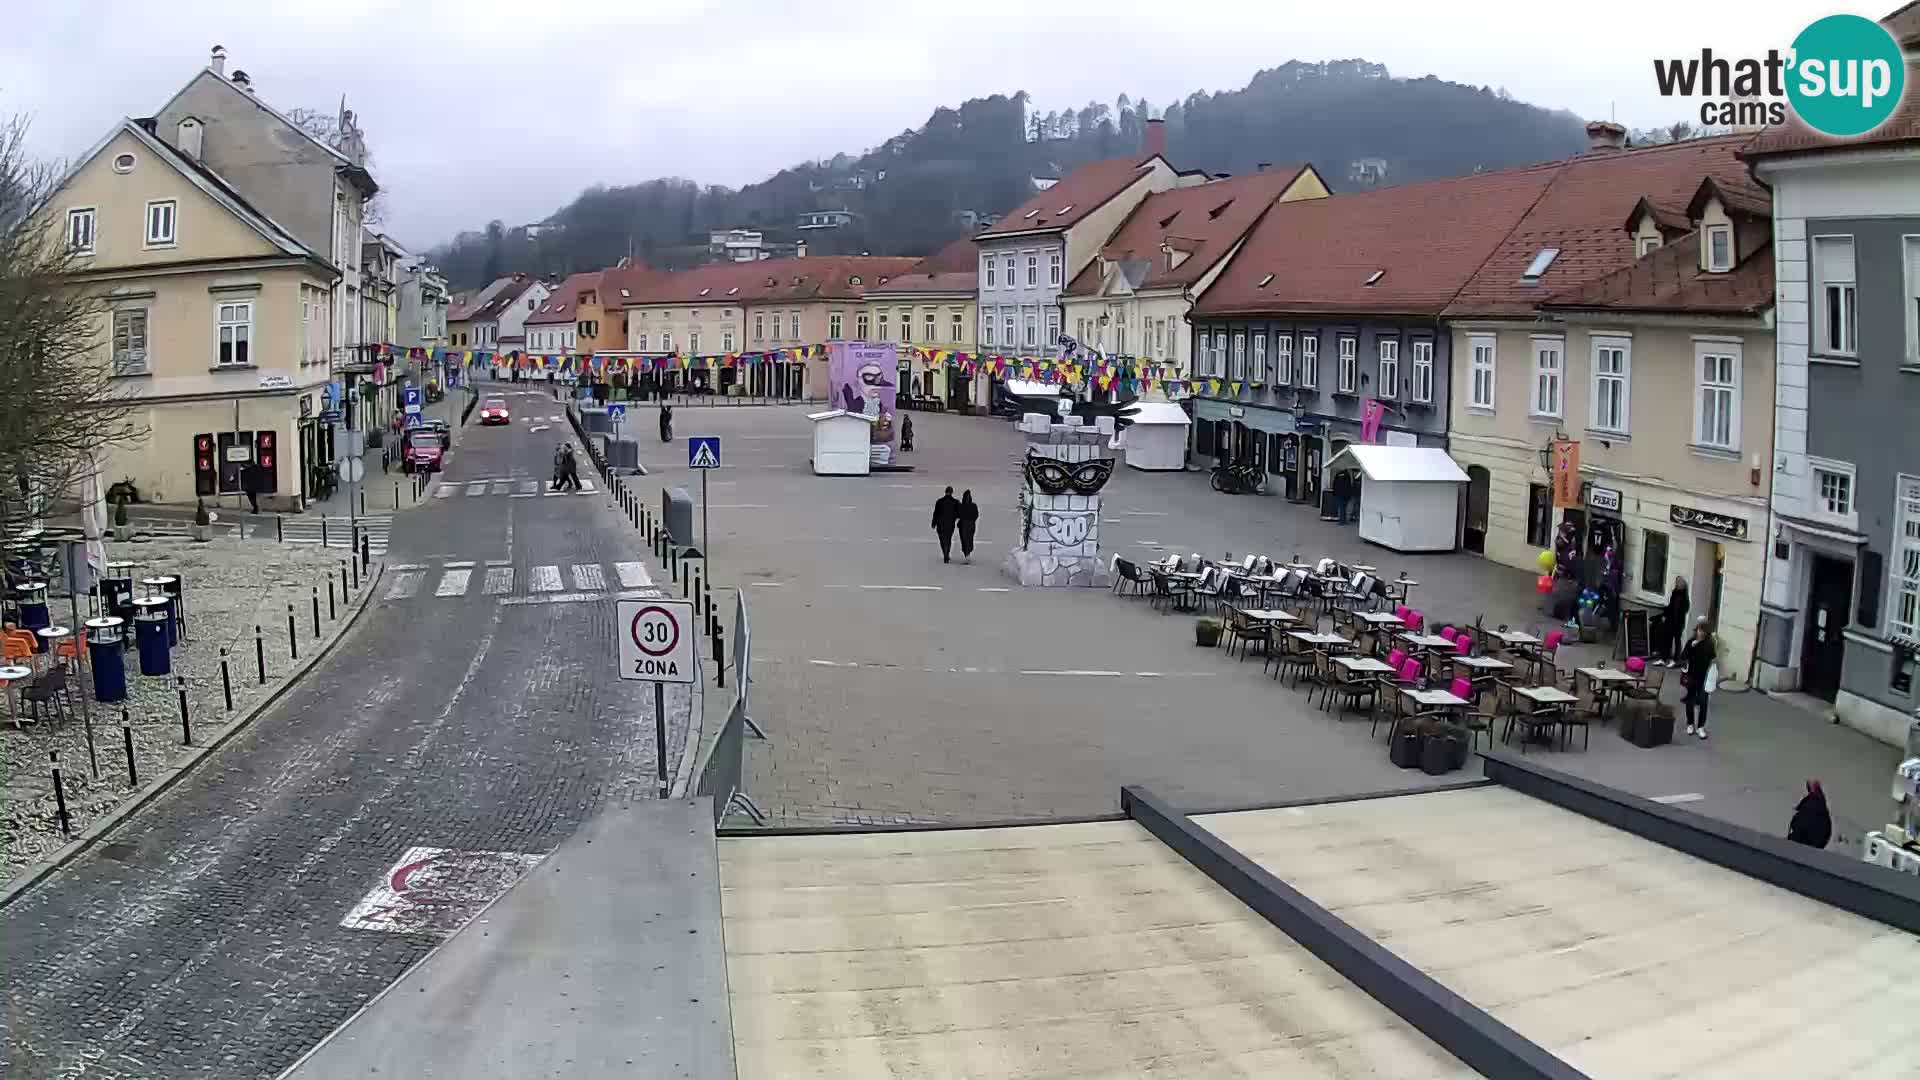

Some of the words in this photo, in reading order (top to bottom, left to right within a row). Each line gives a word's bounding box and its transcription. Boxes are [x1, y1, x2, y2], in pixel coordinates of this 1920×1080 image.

[408, 391, 417, 402] P
[1047, 516, 1088, 545] 200
[644, 621, 668, 643] 30
[634, 659, 679, 676] ZONA
